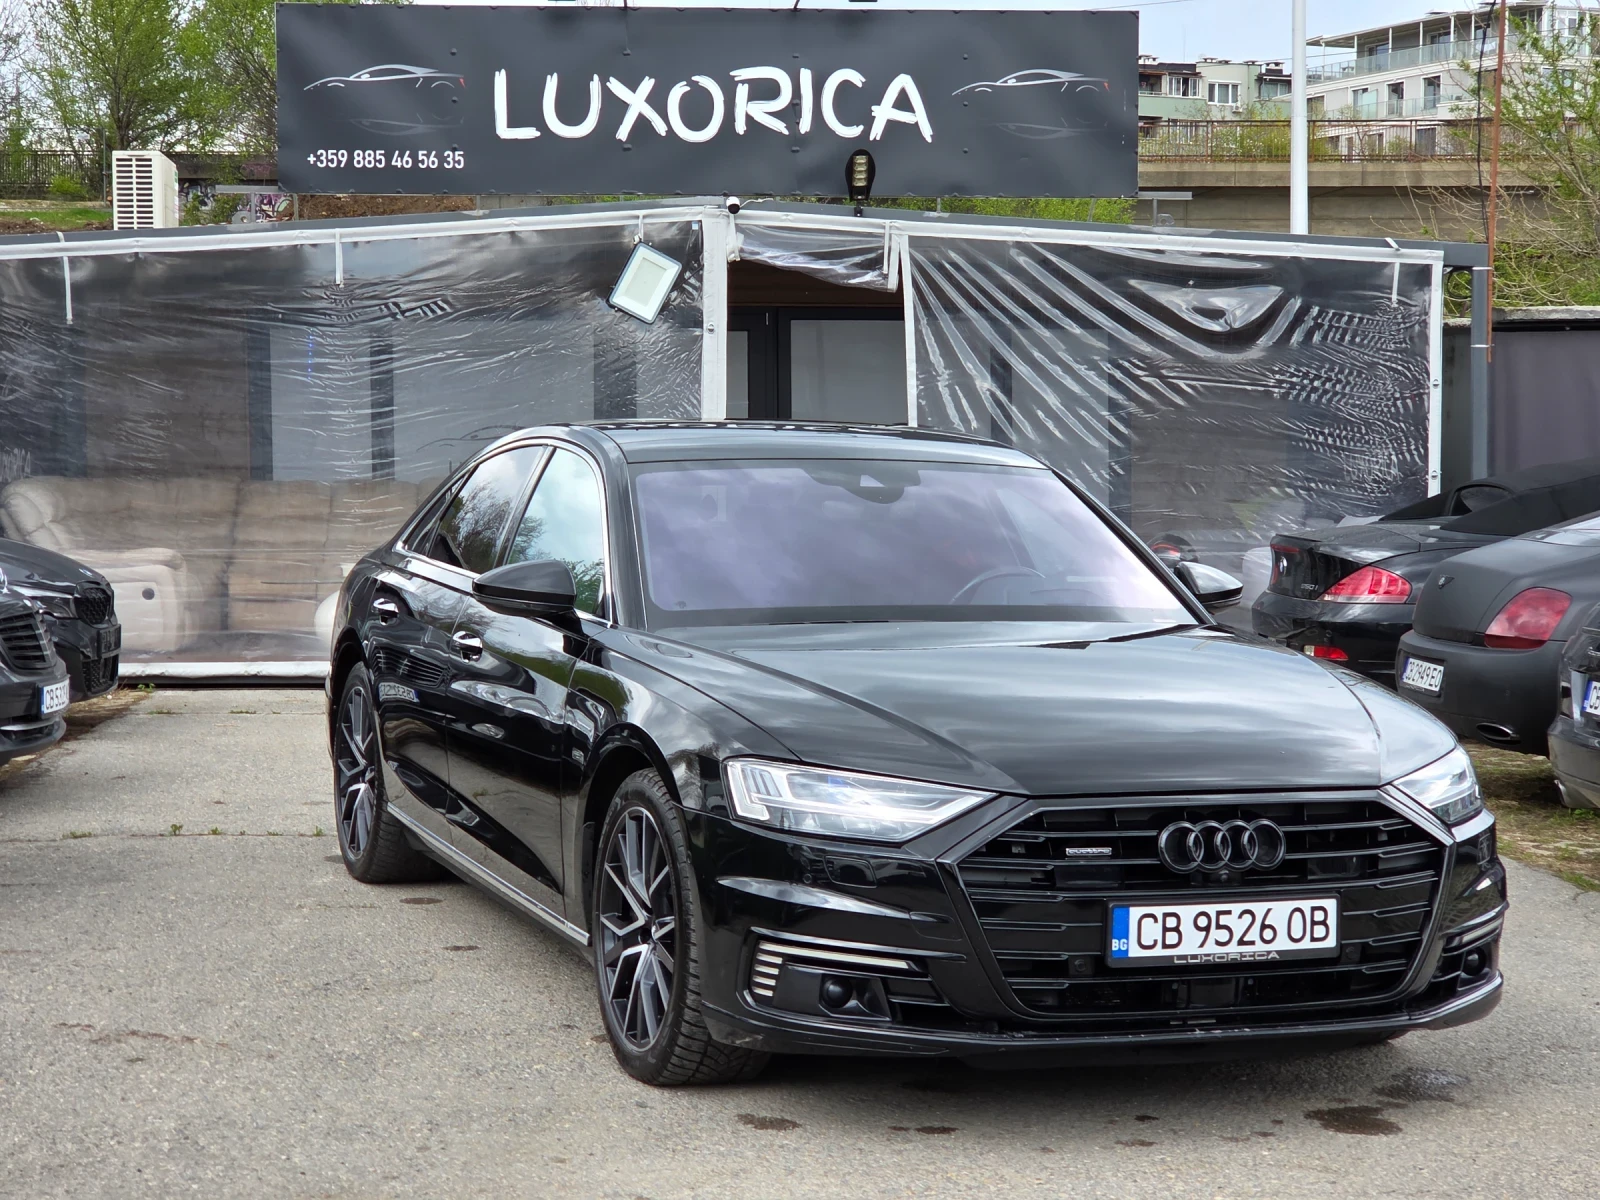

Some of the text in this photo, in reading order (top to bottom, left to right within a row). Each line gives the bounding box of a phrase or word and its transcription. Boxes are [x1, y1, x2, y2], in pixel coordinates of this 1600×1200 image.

[493, 66, 935, 143] LUXORICA
[306, 149, 465, 169] +359 885 46 56 35
[1137, 912, 1183, 950] CB
[1192, 907, 1278, 949] 9526
[1111, 938, 1128, 951] BG
[1174, 952, 1280, 964] LUXORICA
